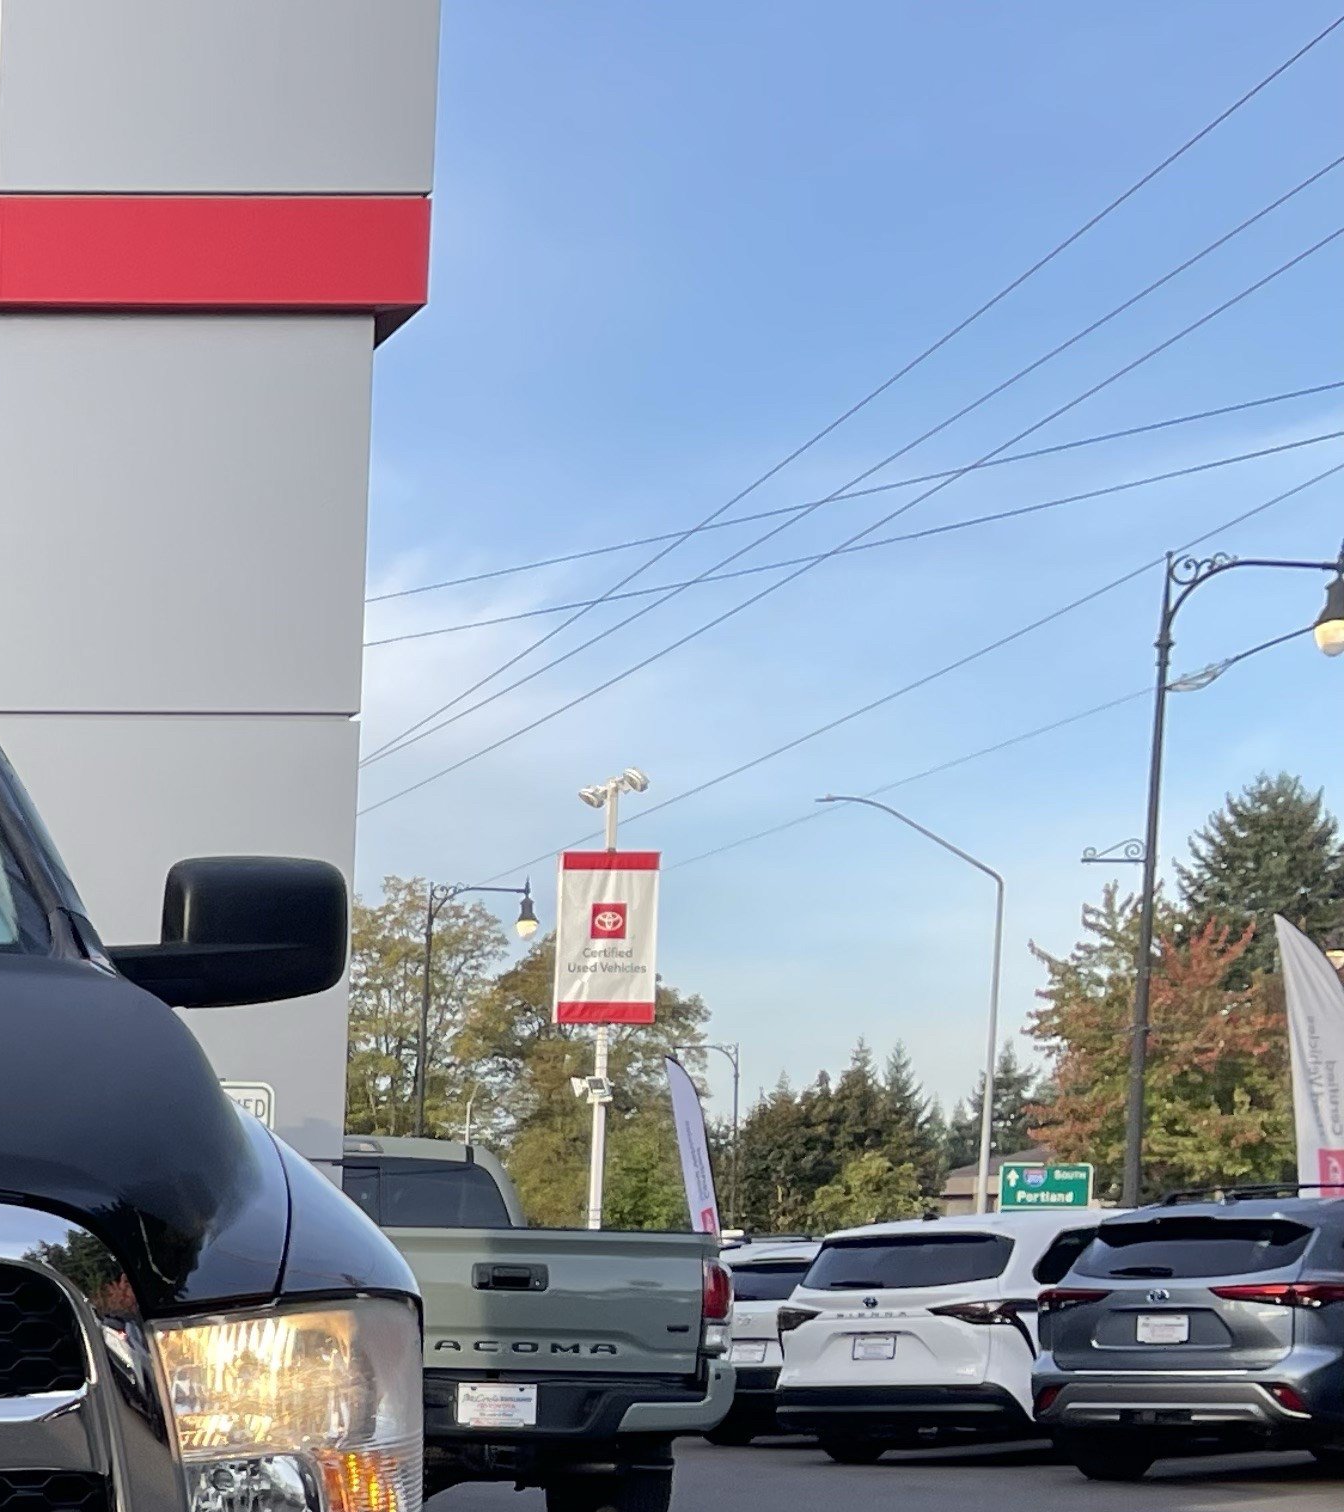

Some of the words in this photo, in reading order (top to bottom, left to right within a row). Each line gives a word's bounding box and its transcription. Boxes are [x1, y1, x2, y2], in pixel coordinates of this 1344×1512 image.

[583, 947, 633, 958] Certified
[568, 962, 597, 973] Used
[600, 962, 646, 973] Vehicles
[1016, 1190, 1074, 1203] Portland
[434, 1340, 618, 1355] ACOMA
